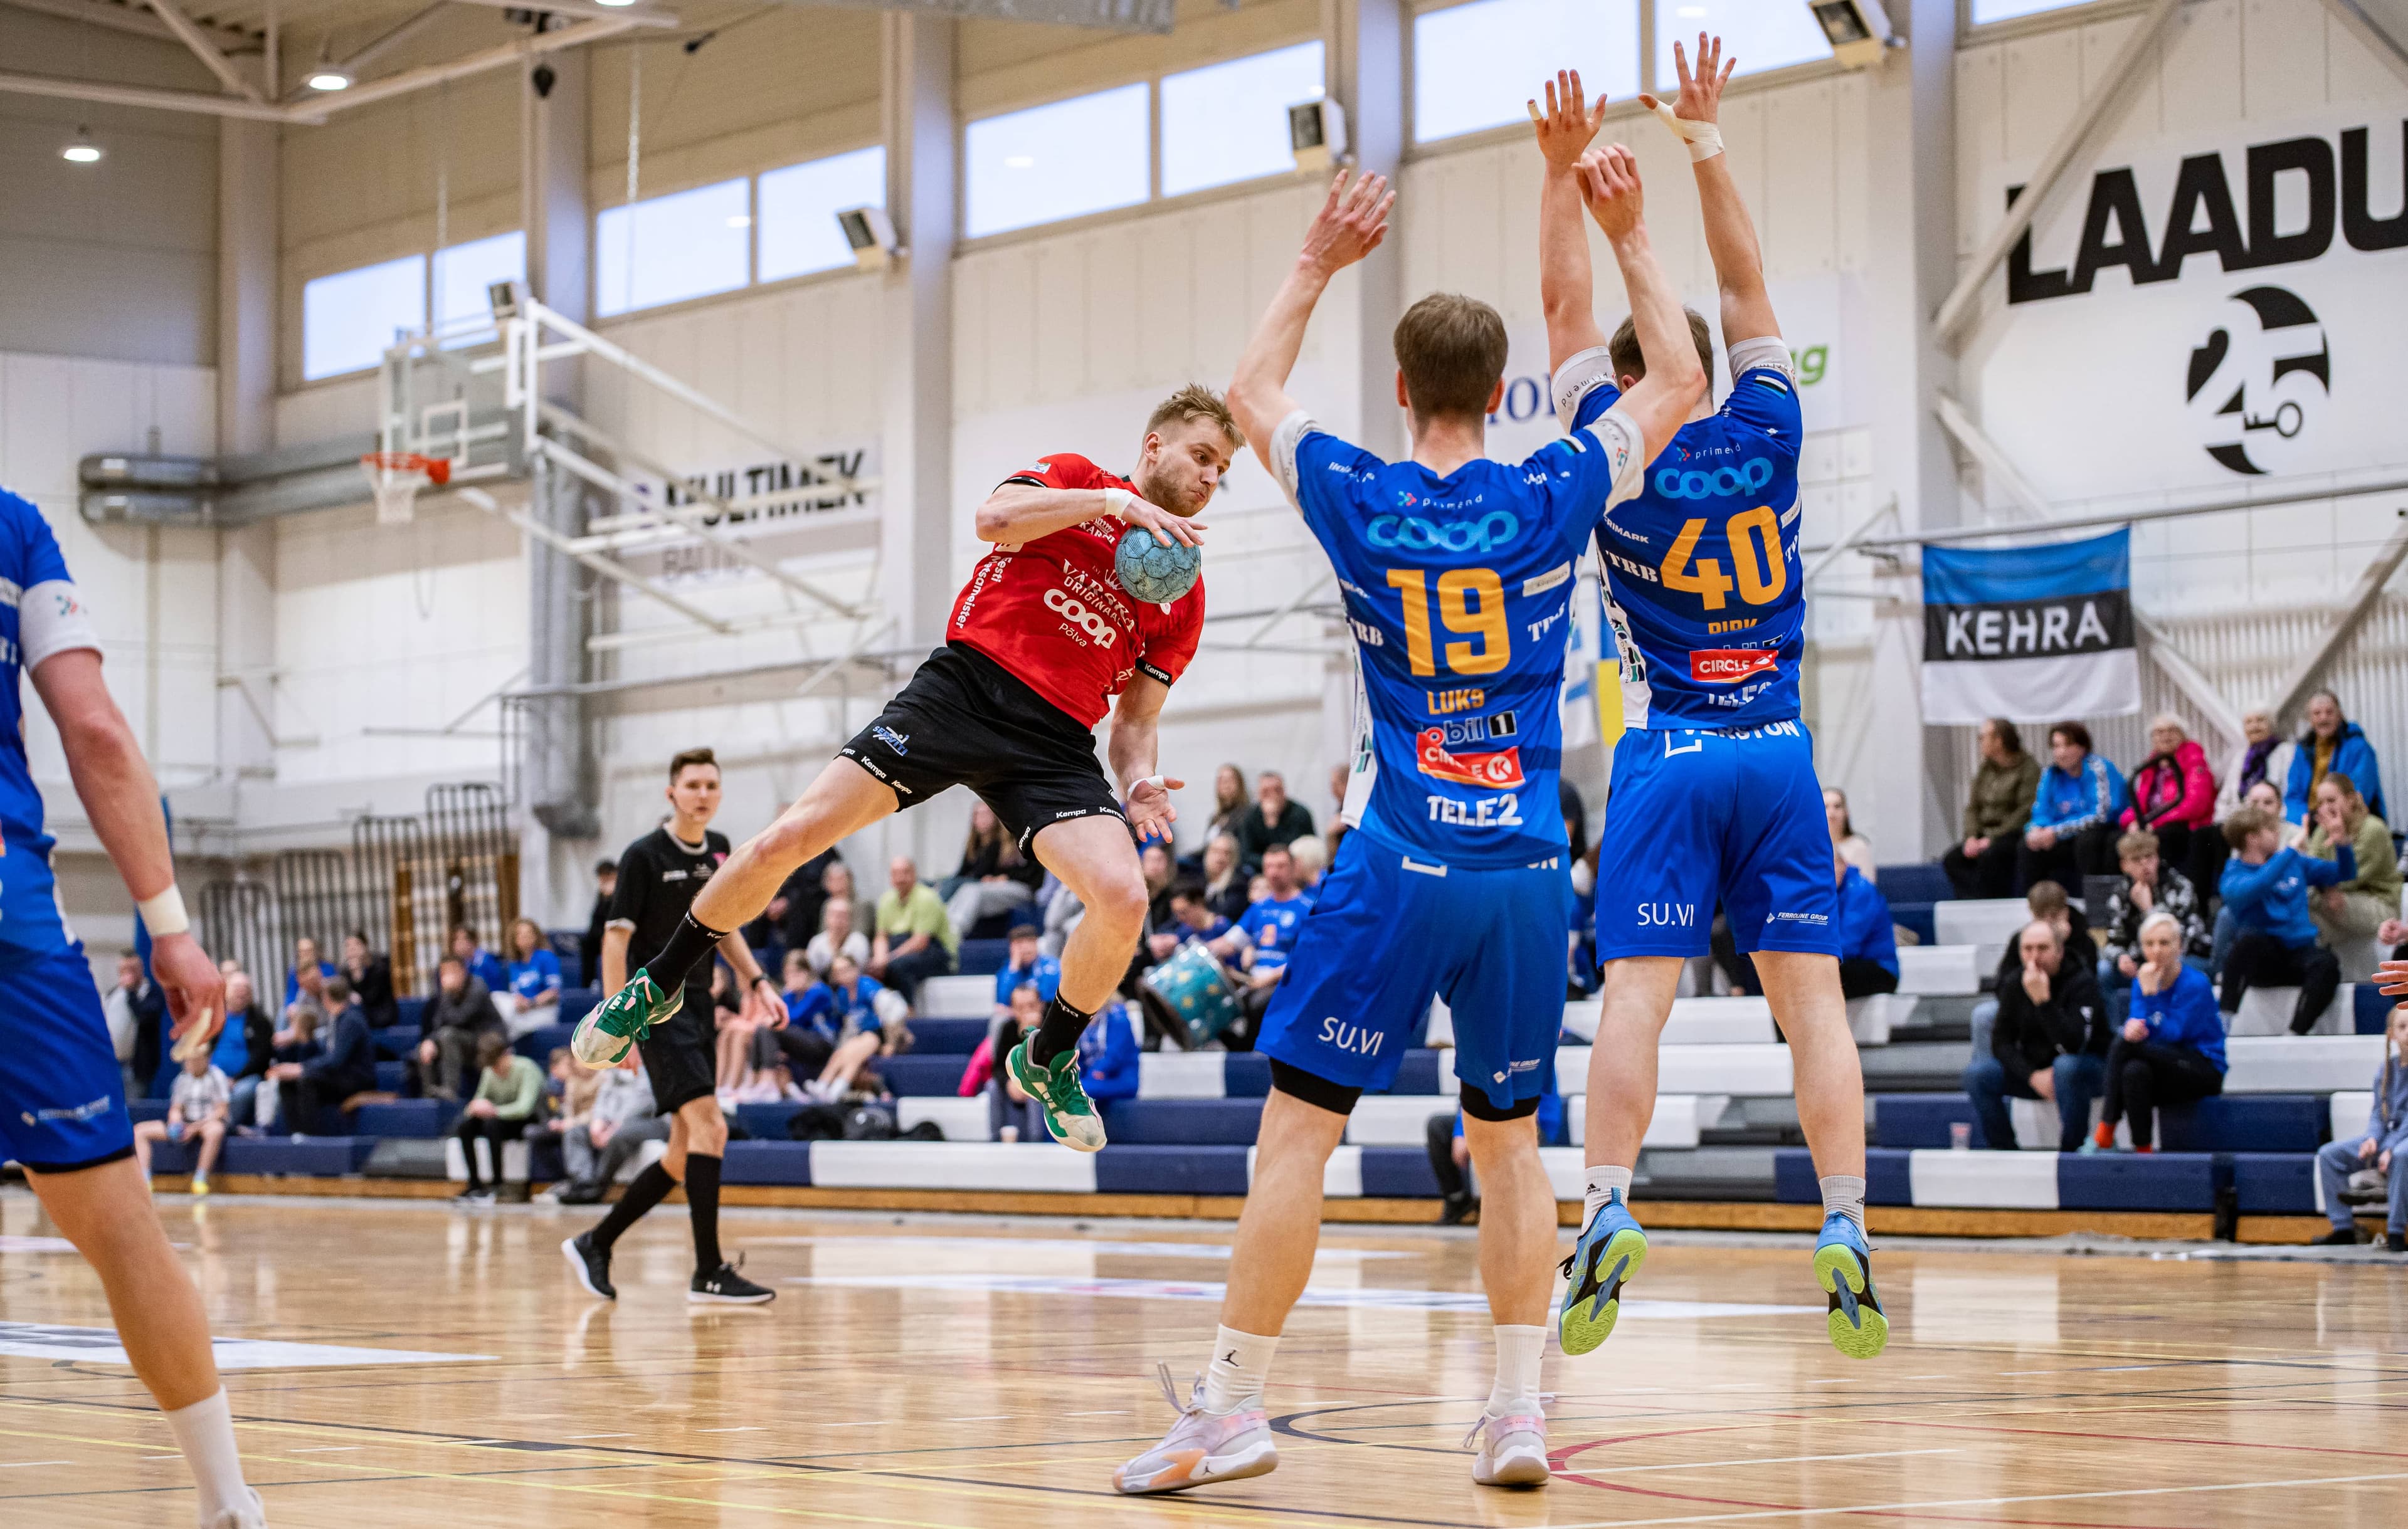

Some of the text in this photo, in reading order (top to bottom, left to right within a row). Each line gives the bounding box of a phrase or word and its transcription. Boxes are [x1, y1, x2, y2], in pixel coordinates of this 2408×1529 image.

[2007, 118, 2408, 305] LAADU
[1654, 457, 1773, 499] coop
[1367, 510, 1519, 552] coop
[1605, 550, 1659, 582] TRB
[1660, 505, 1786, 611] 40
[1043, 588, 1117, 649] coop
[1386, 567, 1511, 677] 19
[1945, 601, 2110, 655] KEHRA
[1059, 623, 1087, 647] Põlva
[1144, 663, 1169, 681] Kempa
[1699, 659, 1750, 673] CIRCLE
[1423, 717, 1485, 746] obil
[861, 755, 887, 779] Kempa
[1489, 757, 1511, 779] K
[891, 780, 913, 794] Kempa
[1056, 809, 1087, 819] Kempa
[1427, 793, 1523, 827] TELE2
[1637, 903, 1694, 927] SU.VI
[1318, 1016, 1384, 1056] SU.VI
